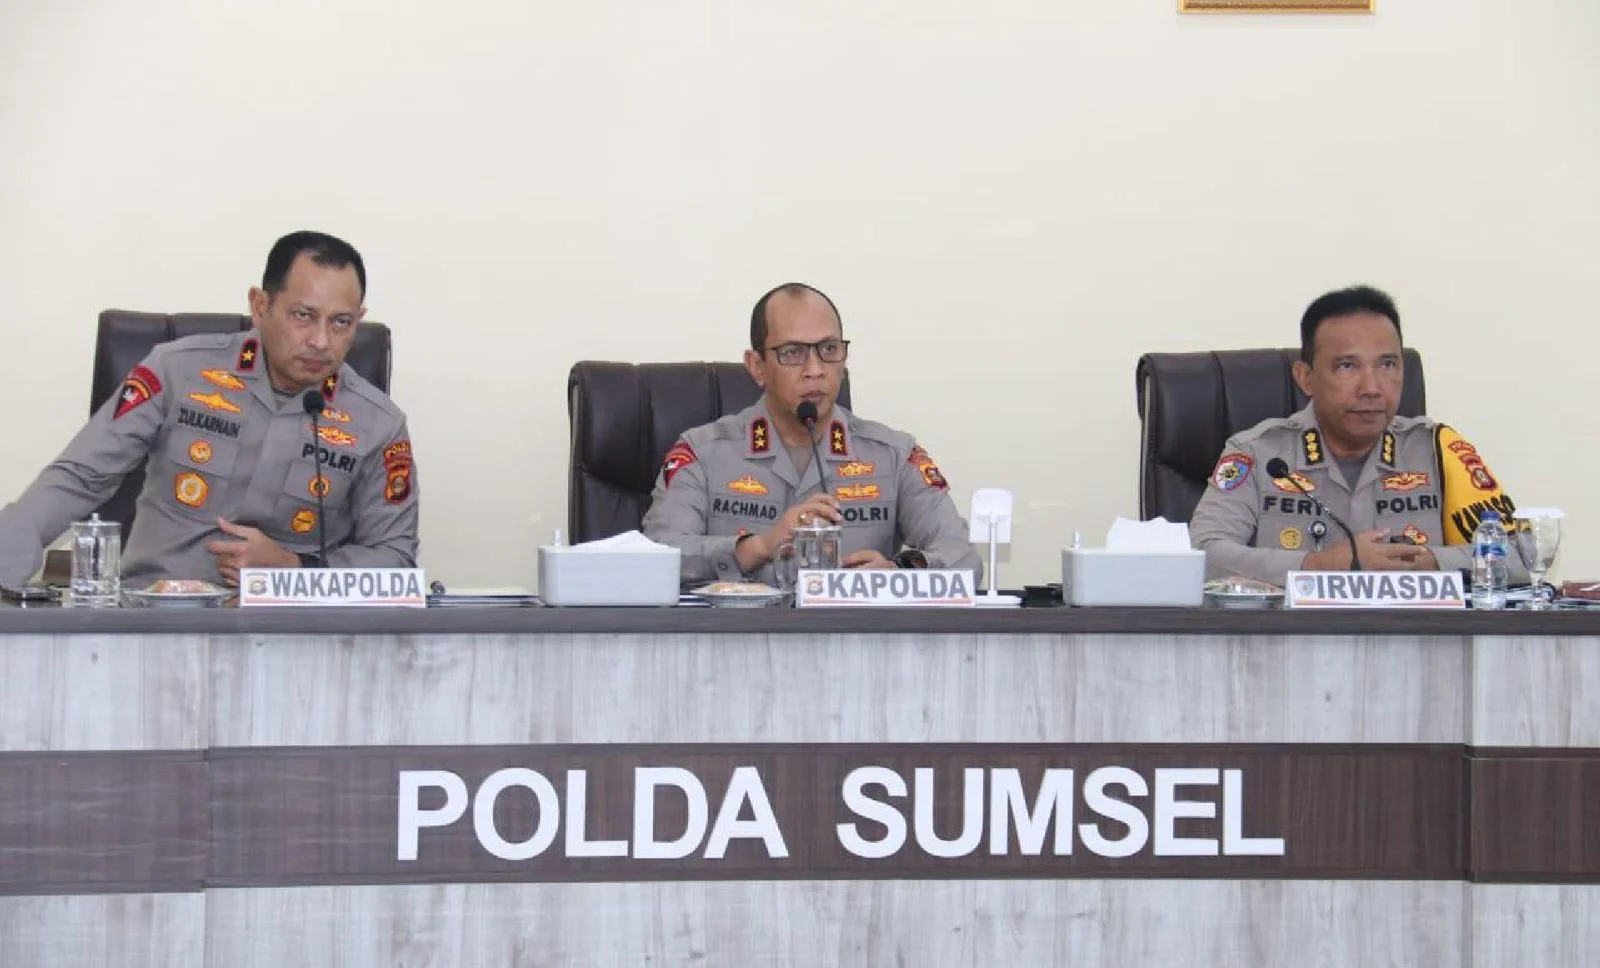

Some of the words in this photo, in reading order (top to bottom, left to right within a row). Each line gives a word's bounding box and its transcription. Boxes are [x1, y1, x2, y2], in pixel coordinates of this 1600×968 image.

[302, 442, 357, 473] POLRI
[712, 497, 778, 520] RACHMAD
[836, 506, 889, 522] OLRI
[1376, 494, 1438, 515] POLRI
[270, 571, 422, 598] WAKAPOLDA
[827, 572, 969, 599] KAPOLDA
[1316, 574, 1460, 601] IRWASDA
[397, 766, 789, 861] POLDA
[837, 766, 1285, 858] SUMSEL
